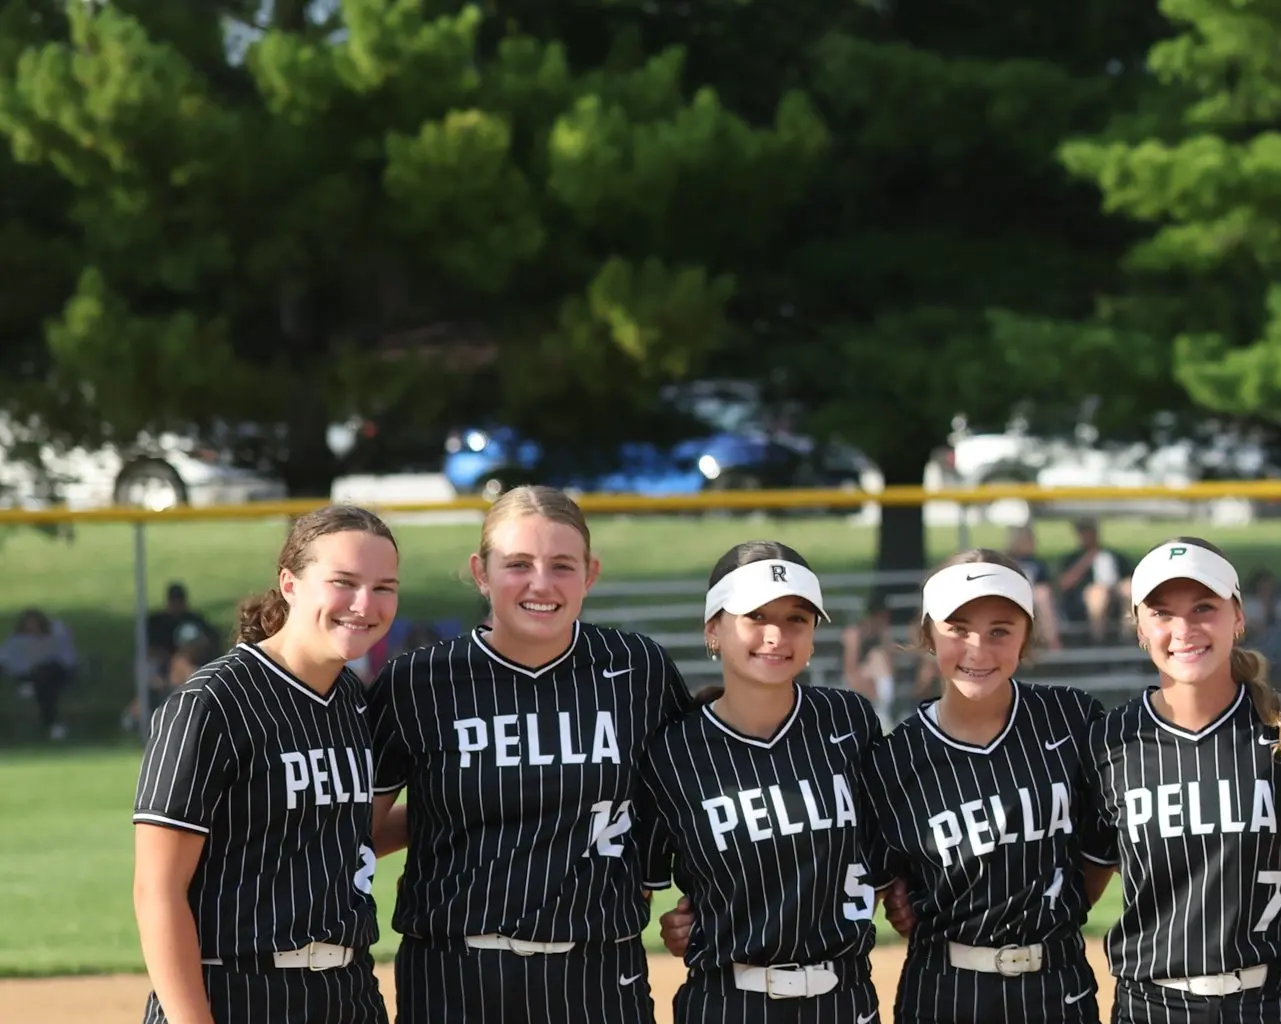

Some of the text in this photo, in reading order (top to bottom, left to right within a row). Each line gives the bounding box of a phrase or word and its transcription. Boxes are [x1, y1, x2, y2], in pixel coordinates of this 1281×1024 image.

[770, 564, 788, 583] R
[1169, 547, 1187, 560] P
[453, 711, 621, 768] PELLA
[581, 799, 632, 859] 12
[701, 774, 857, 852] PELLA
[928, 782, 1073, 867] PELLA
[1124, 779, 1277, 844] PELLA
[842, 863, 875, 921] 5
